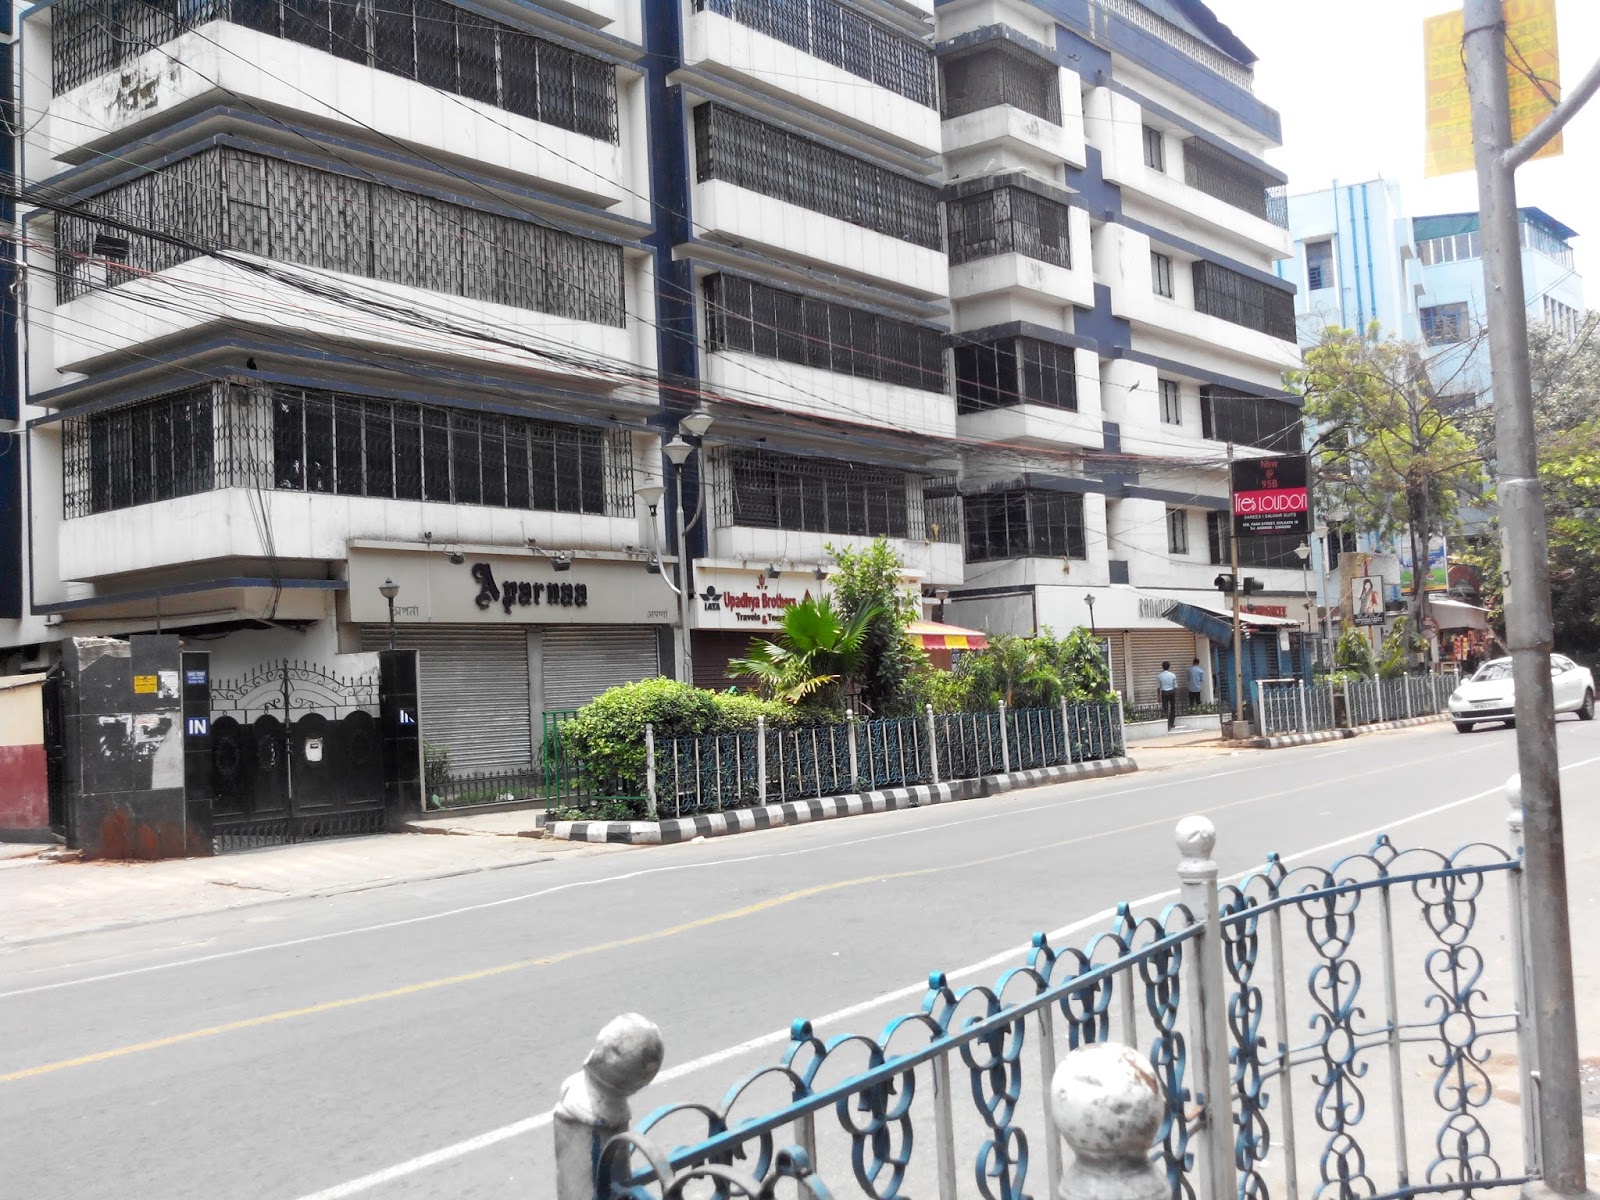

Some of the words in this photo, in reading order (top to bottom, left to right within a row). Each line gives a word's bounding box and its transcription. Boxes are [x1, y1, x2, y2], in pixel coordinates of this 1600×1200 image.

[1265, 469, 1274, 478] @
[1261, 479, 1278, 489] 95B
[471, 562, 588, 615] Aparnaa
[704, 602, 721, 611] IATA
[723, 591, 760, 612] Upadhya
[761, 592, 797, 609] Brothers
[736, 612, 761, 621] Travels
[762, 615, 768, 625] &
[188, 719, 207, 735] IN
